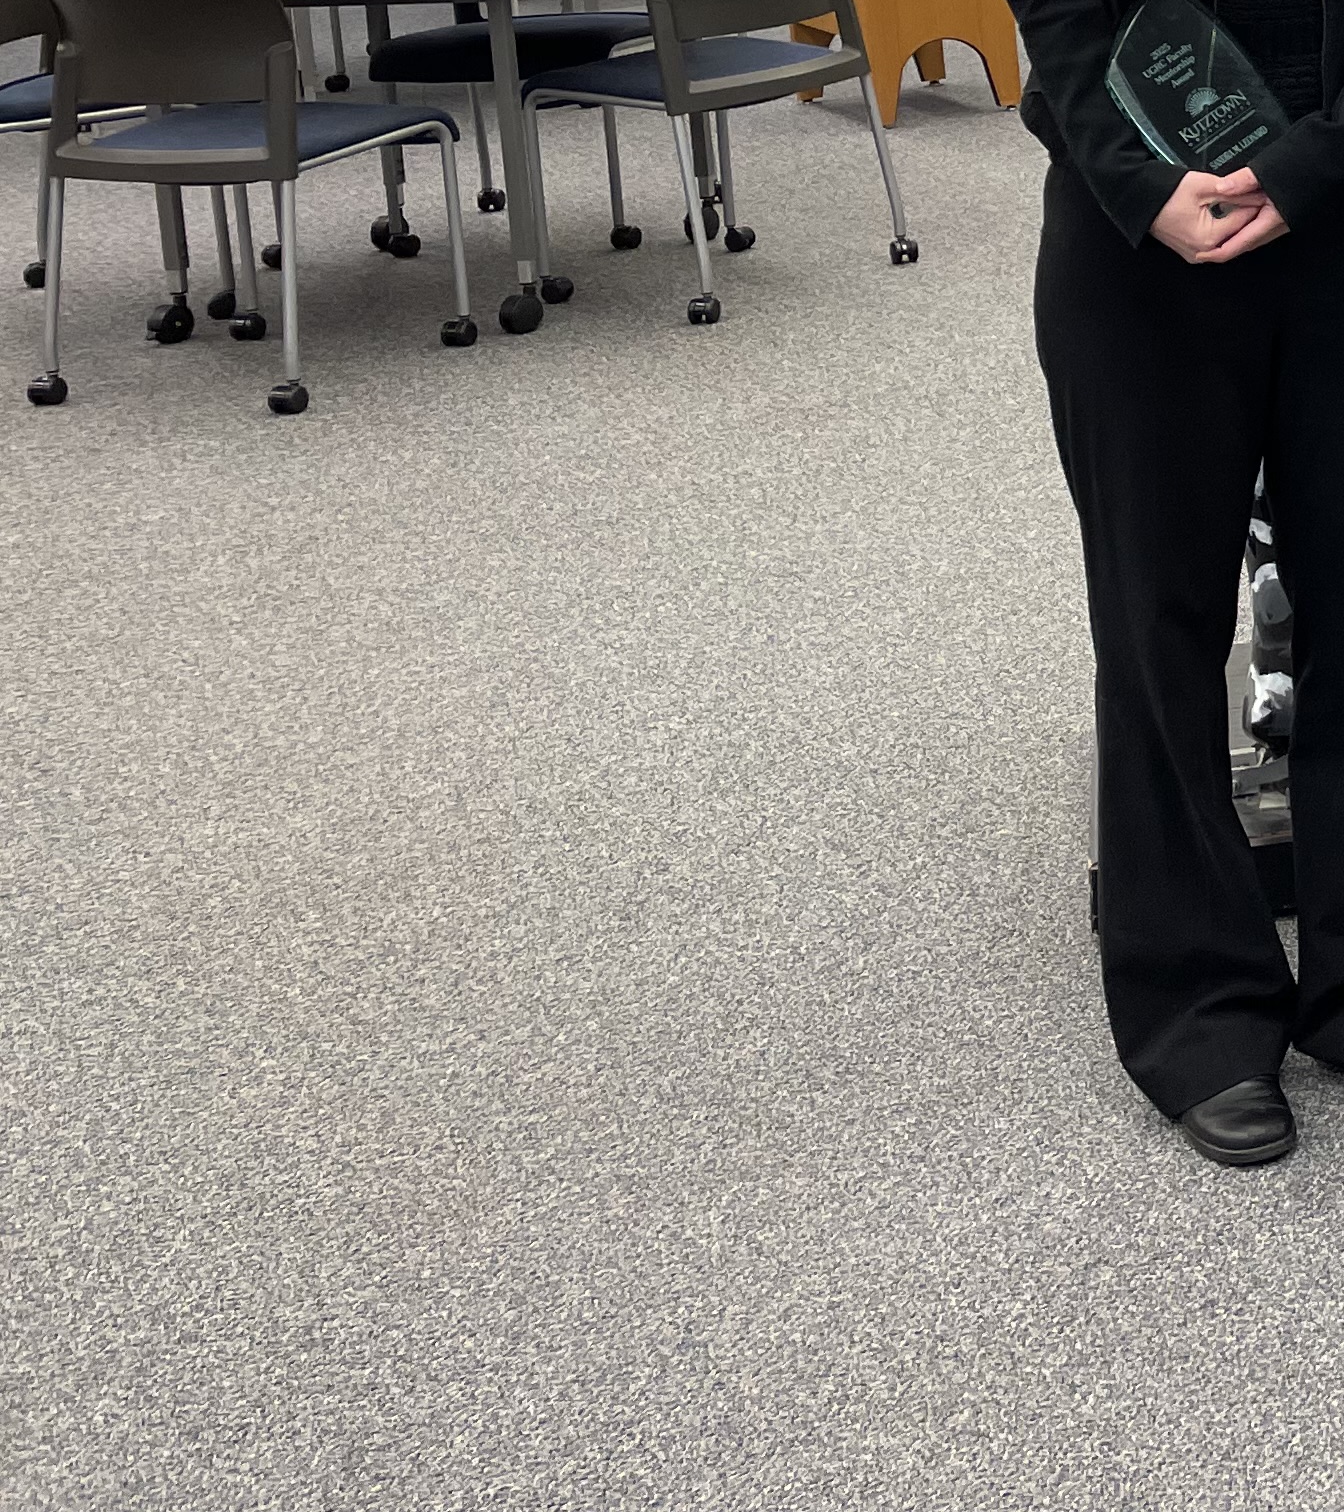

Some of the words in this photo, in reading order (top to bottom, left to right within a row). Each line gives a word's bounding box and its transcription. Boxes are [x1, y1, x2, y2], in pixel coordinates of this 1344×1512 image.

[1165, 43, 1193, 64] Faculty
[1153, 55, 1196, 86] Mentorship
[1170, 67, 1196, 89] Award
[1178, 88, 1247, 143] KUTZTOWN
